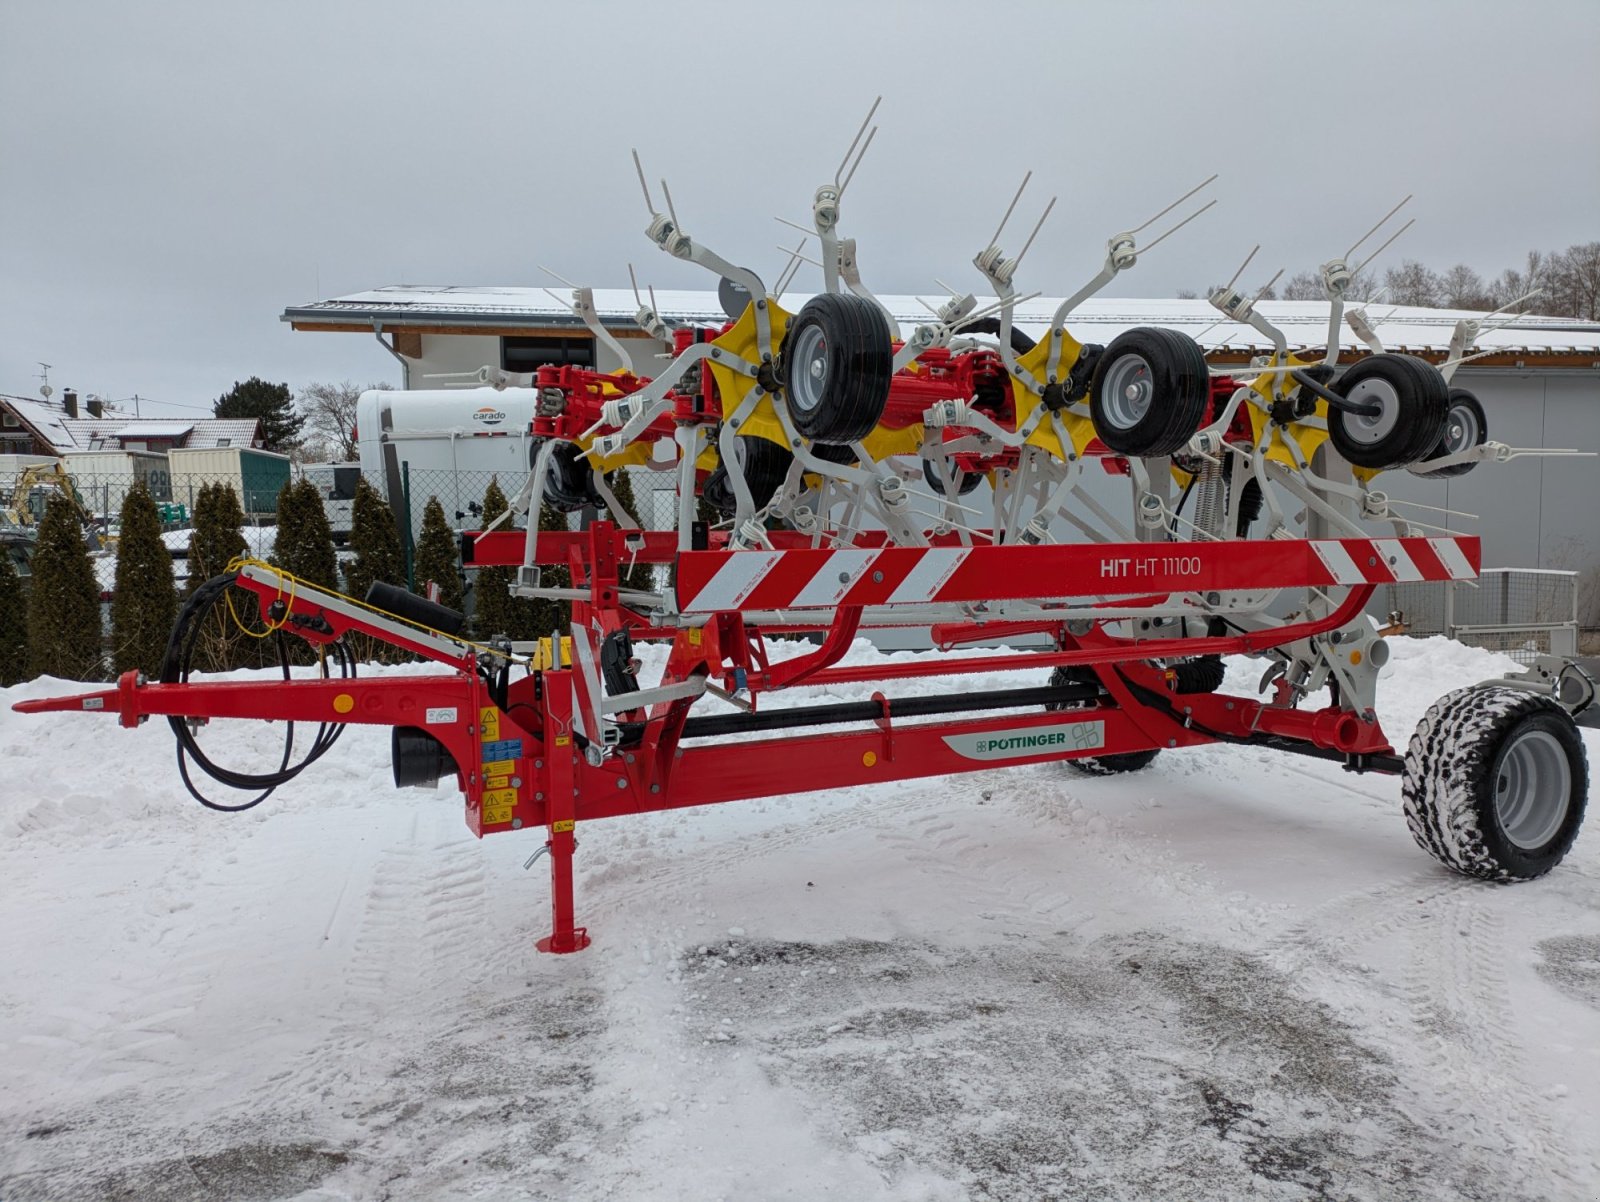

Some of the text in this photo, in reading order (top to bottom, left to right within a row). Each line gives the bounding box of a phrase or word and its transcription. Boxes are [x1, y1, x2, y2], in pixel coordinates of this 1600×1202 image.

[472, 411, 506, 420] carado
[1101, 556, 1201, 577] HIT HT 11100
